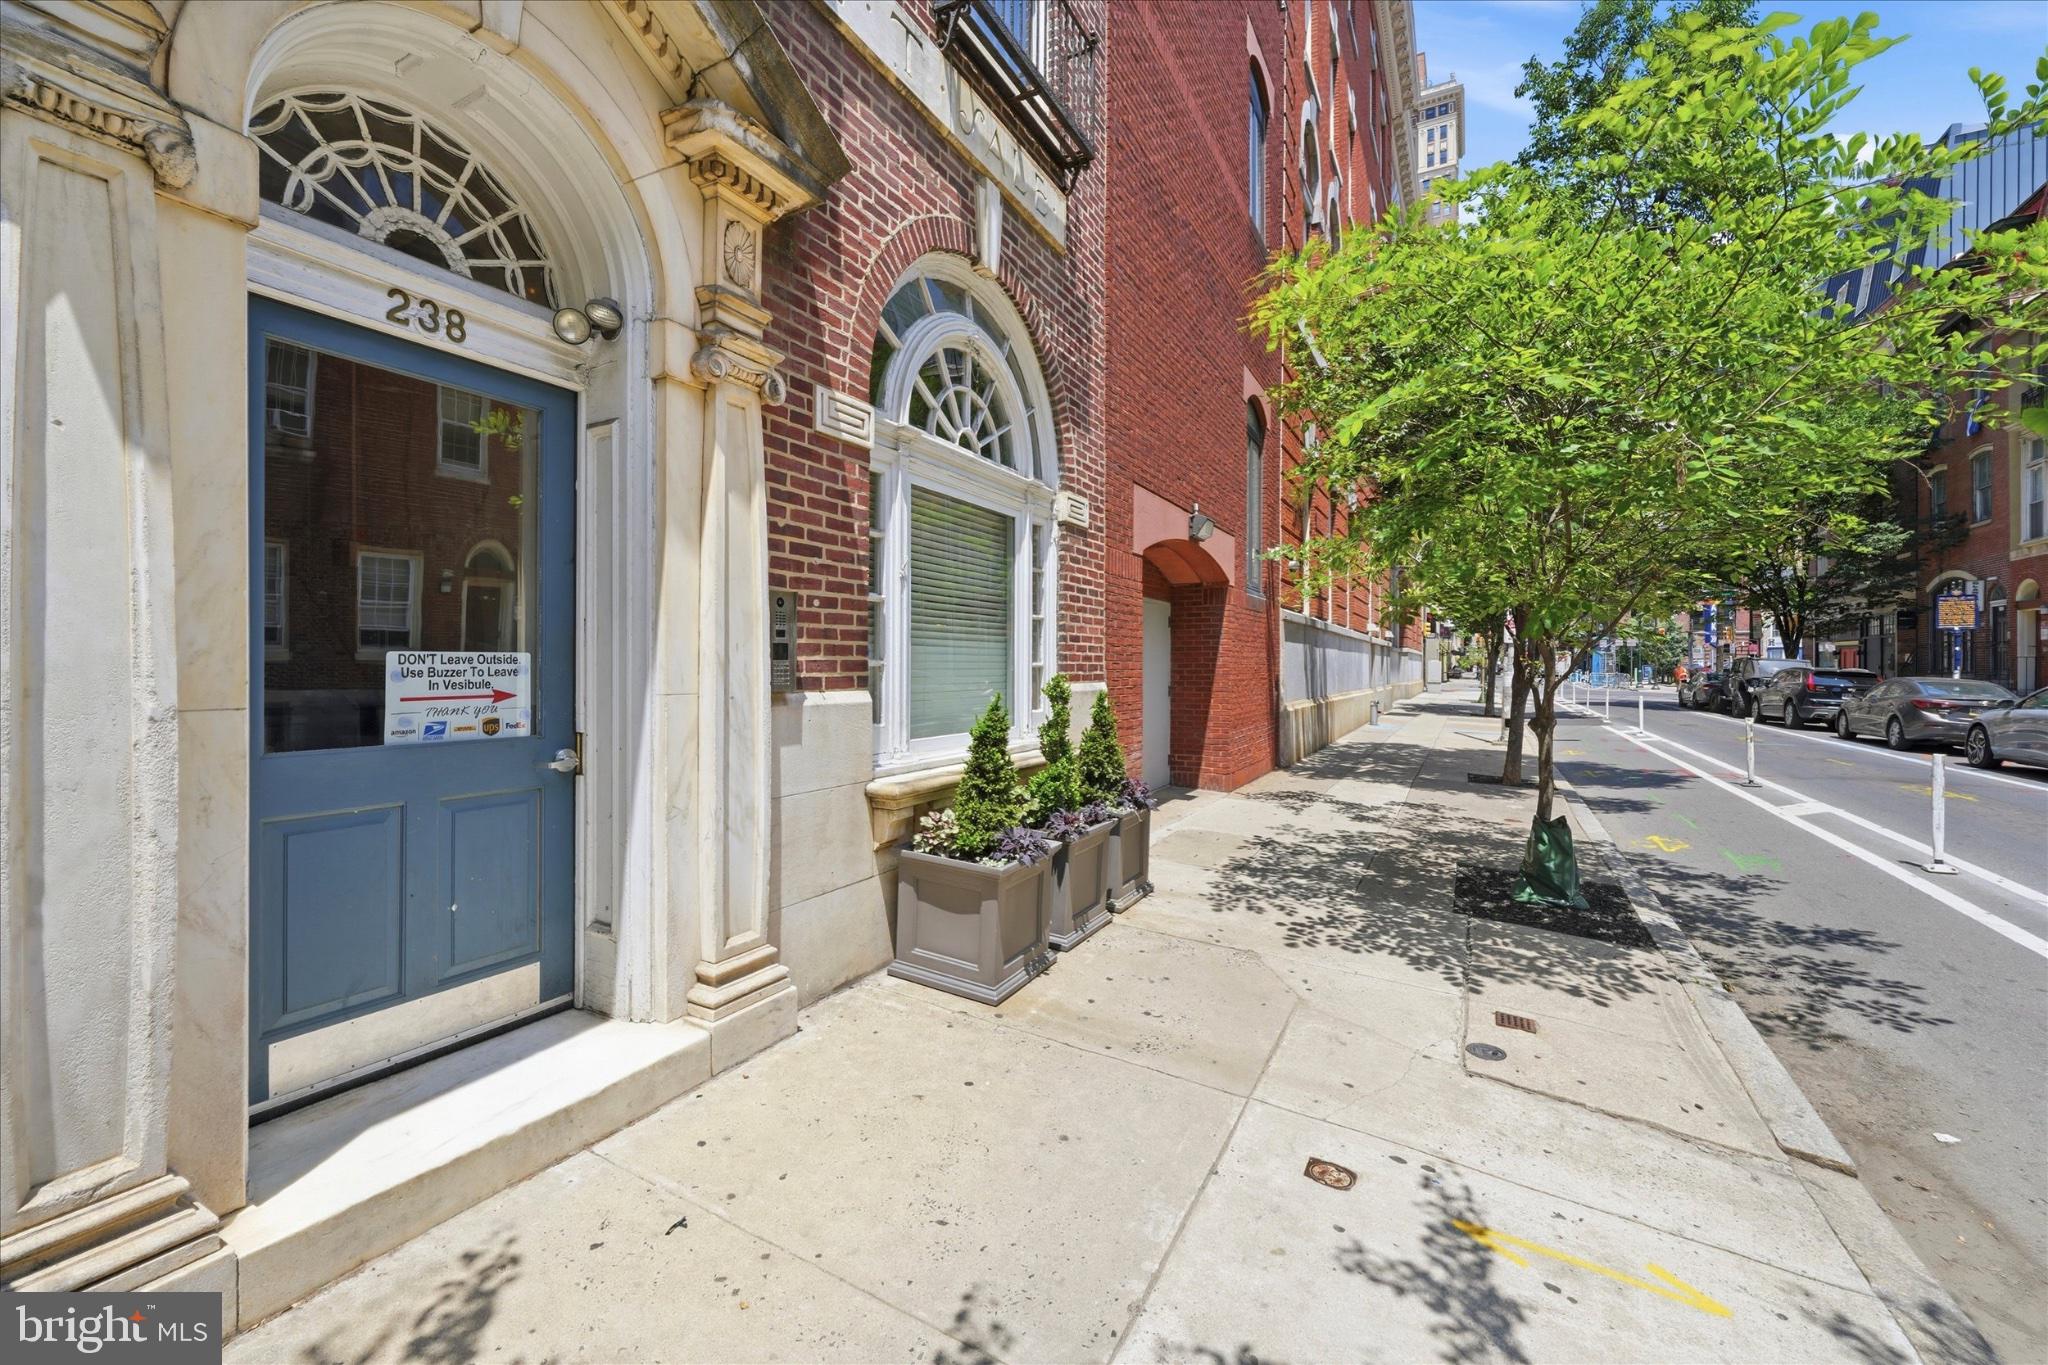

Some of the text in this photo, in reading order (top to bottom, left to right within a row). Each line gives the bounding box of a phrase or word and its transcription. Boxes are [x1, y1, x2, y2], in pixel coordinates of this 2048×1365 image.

[386, 288, 467, 343] 238
[398, 653, 437, 665] DON'T
[440, 654, 474, 665] Leave
[400, 666, 519, 679] Use Buzzer To Leave
[428, 679, 494, 691] In Vesibule.
[483, 721, 500, 733] ups
[505, 722, 526, 730] FedEx
[390, 728, 417, 737] amazon
